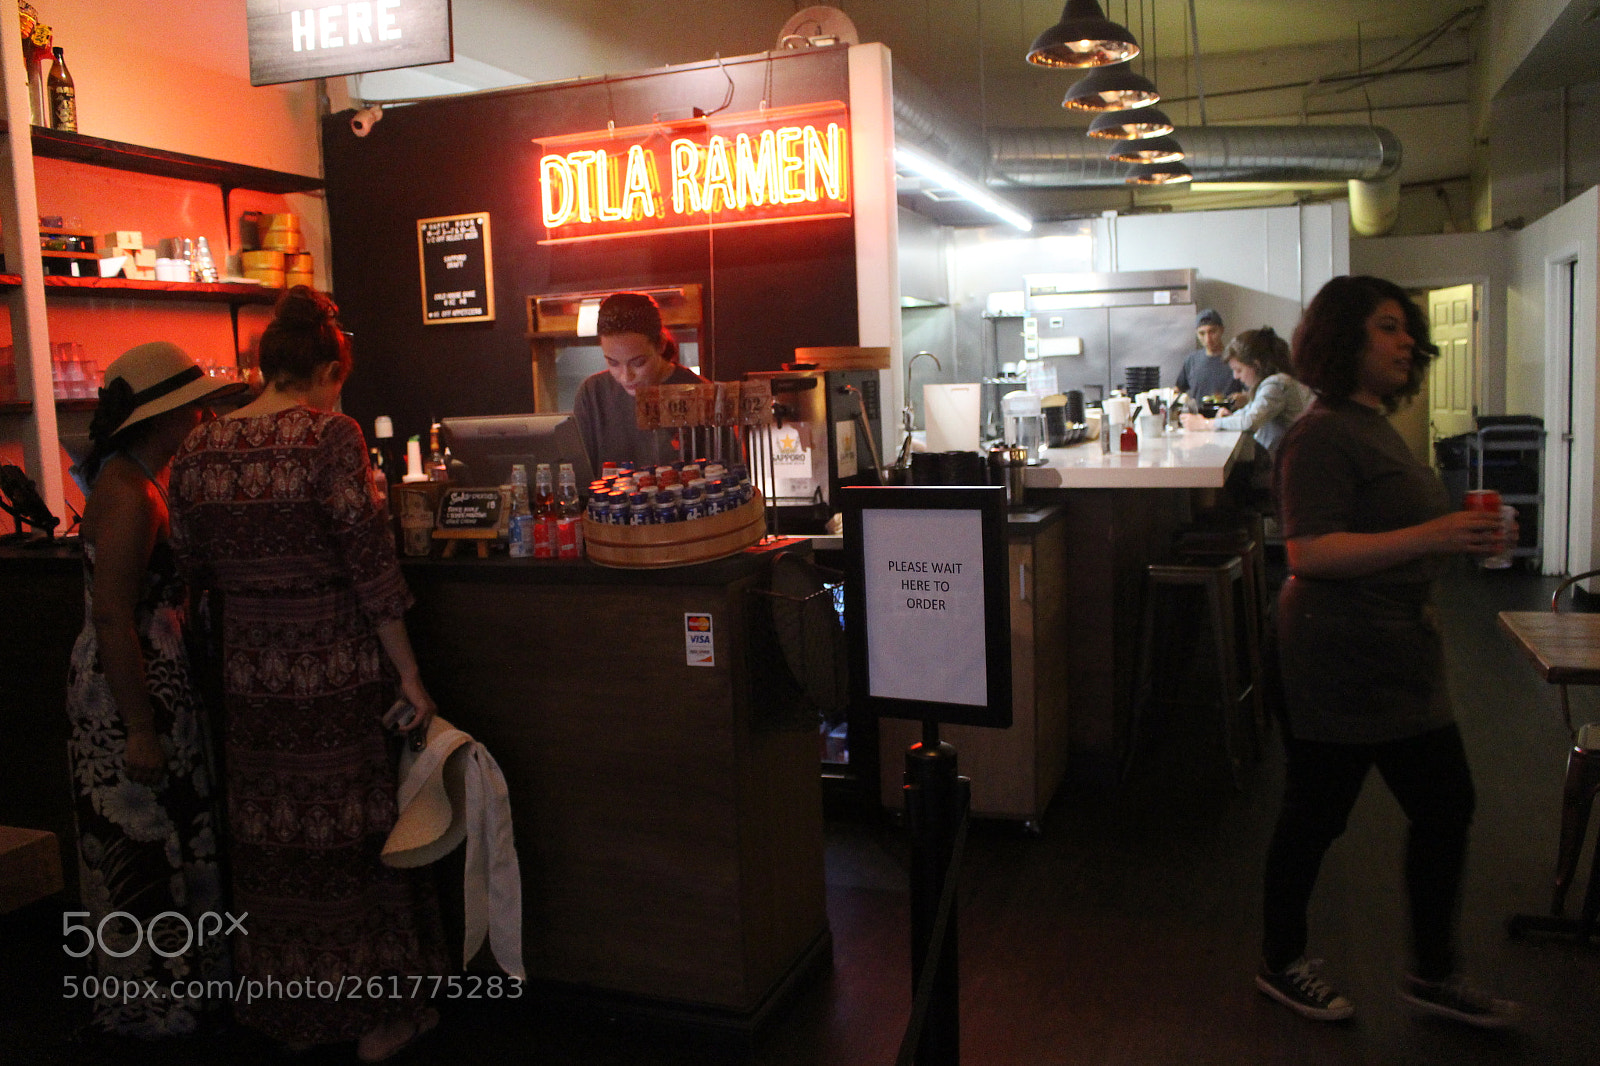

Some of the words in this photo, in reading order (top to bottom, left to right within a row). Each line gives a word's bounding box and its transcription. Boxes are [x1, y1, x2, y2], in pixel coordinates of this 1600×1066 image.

[291, 1, 402, 52] HERE
[540, 144, 655, 228] DTLA
[670, 122, 840, 214] RAMEN
[888, 560, 928, 573] PLEASE
[932, 562, 963, 574] WAIT
[901, 579, 930, 592] HERE
[934, 580, 950, 593] TO
[906, 597, 946, 611] ORDER
[690, 635, 710, 644] VISA
